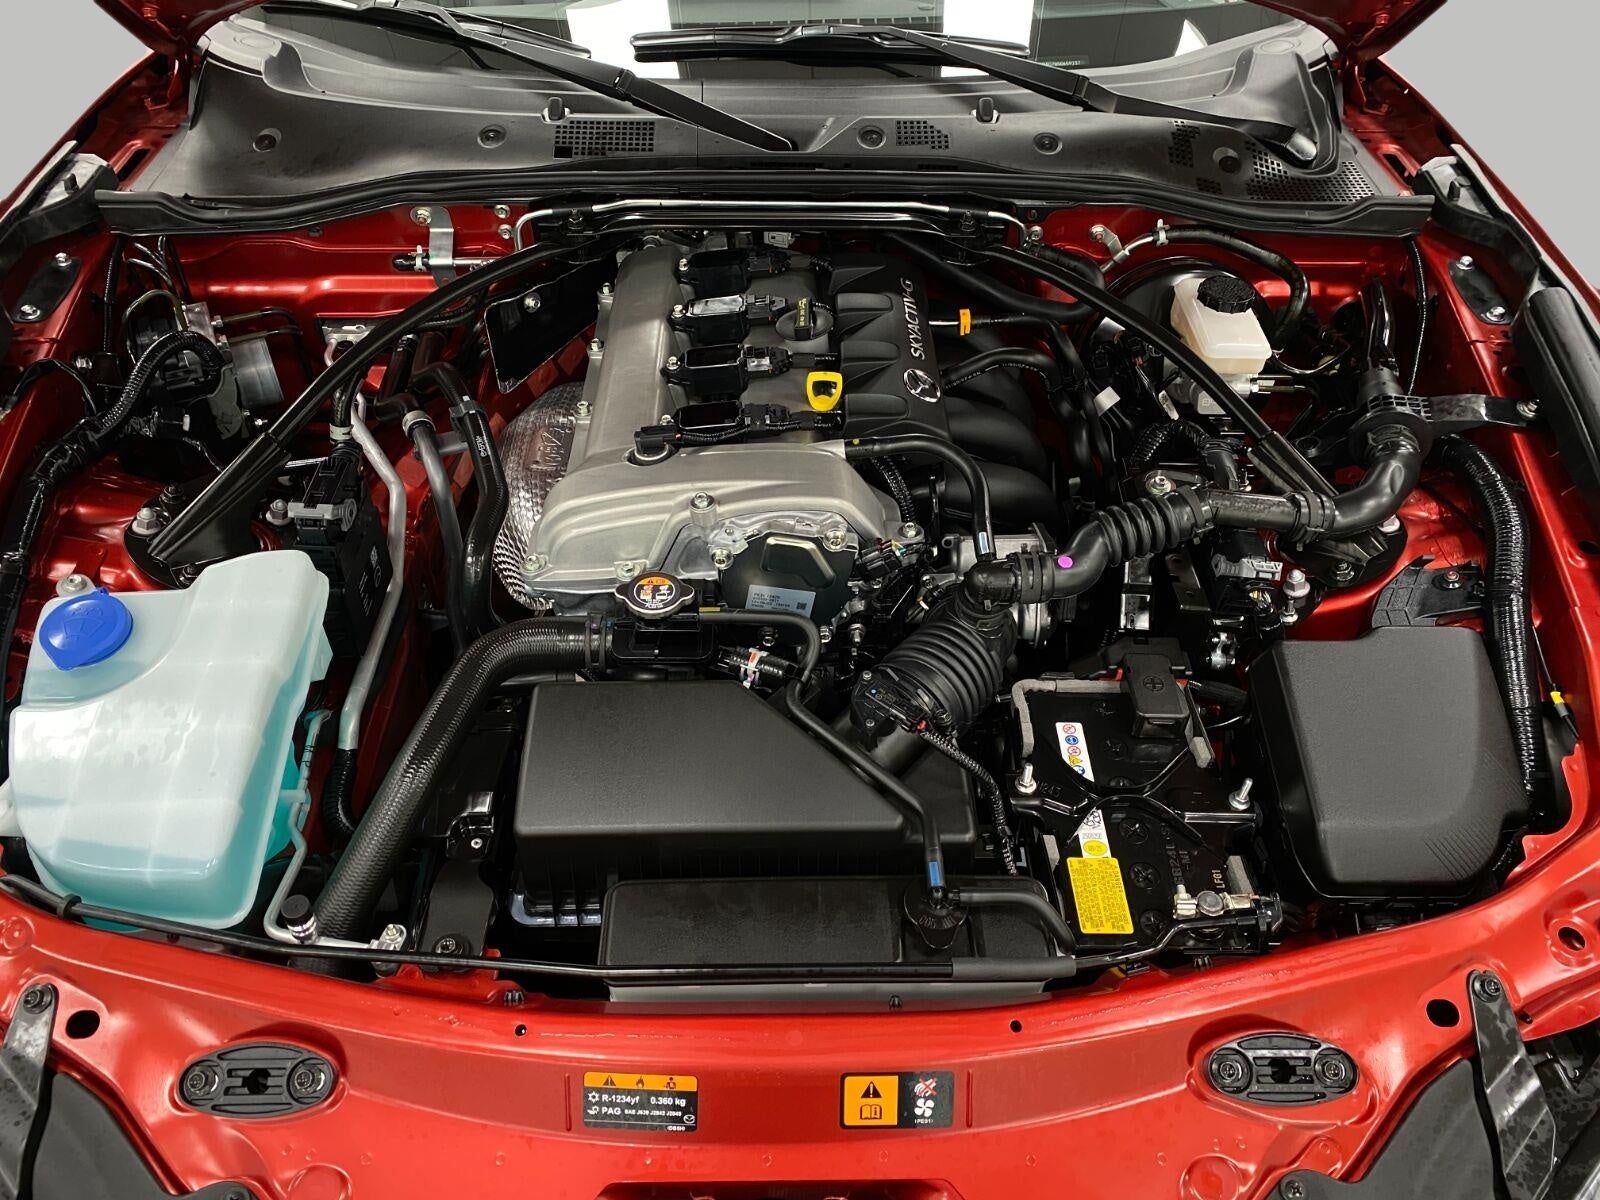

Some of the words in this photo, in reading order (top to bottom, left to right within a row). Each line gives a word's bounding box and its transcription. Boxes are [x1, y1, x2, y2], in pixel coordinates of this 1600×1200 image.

[900, 277, 926, 361] SKYACTIV-G
[602, 1095, 640, 1105] R-1234yf
[674, 1098, 686, 1107] kg
[601, 1107, 621, 1115] PAG
